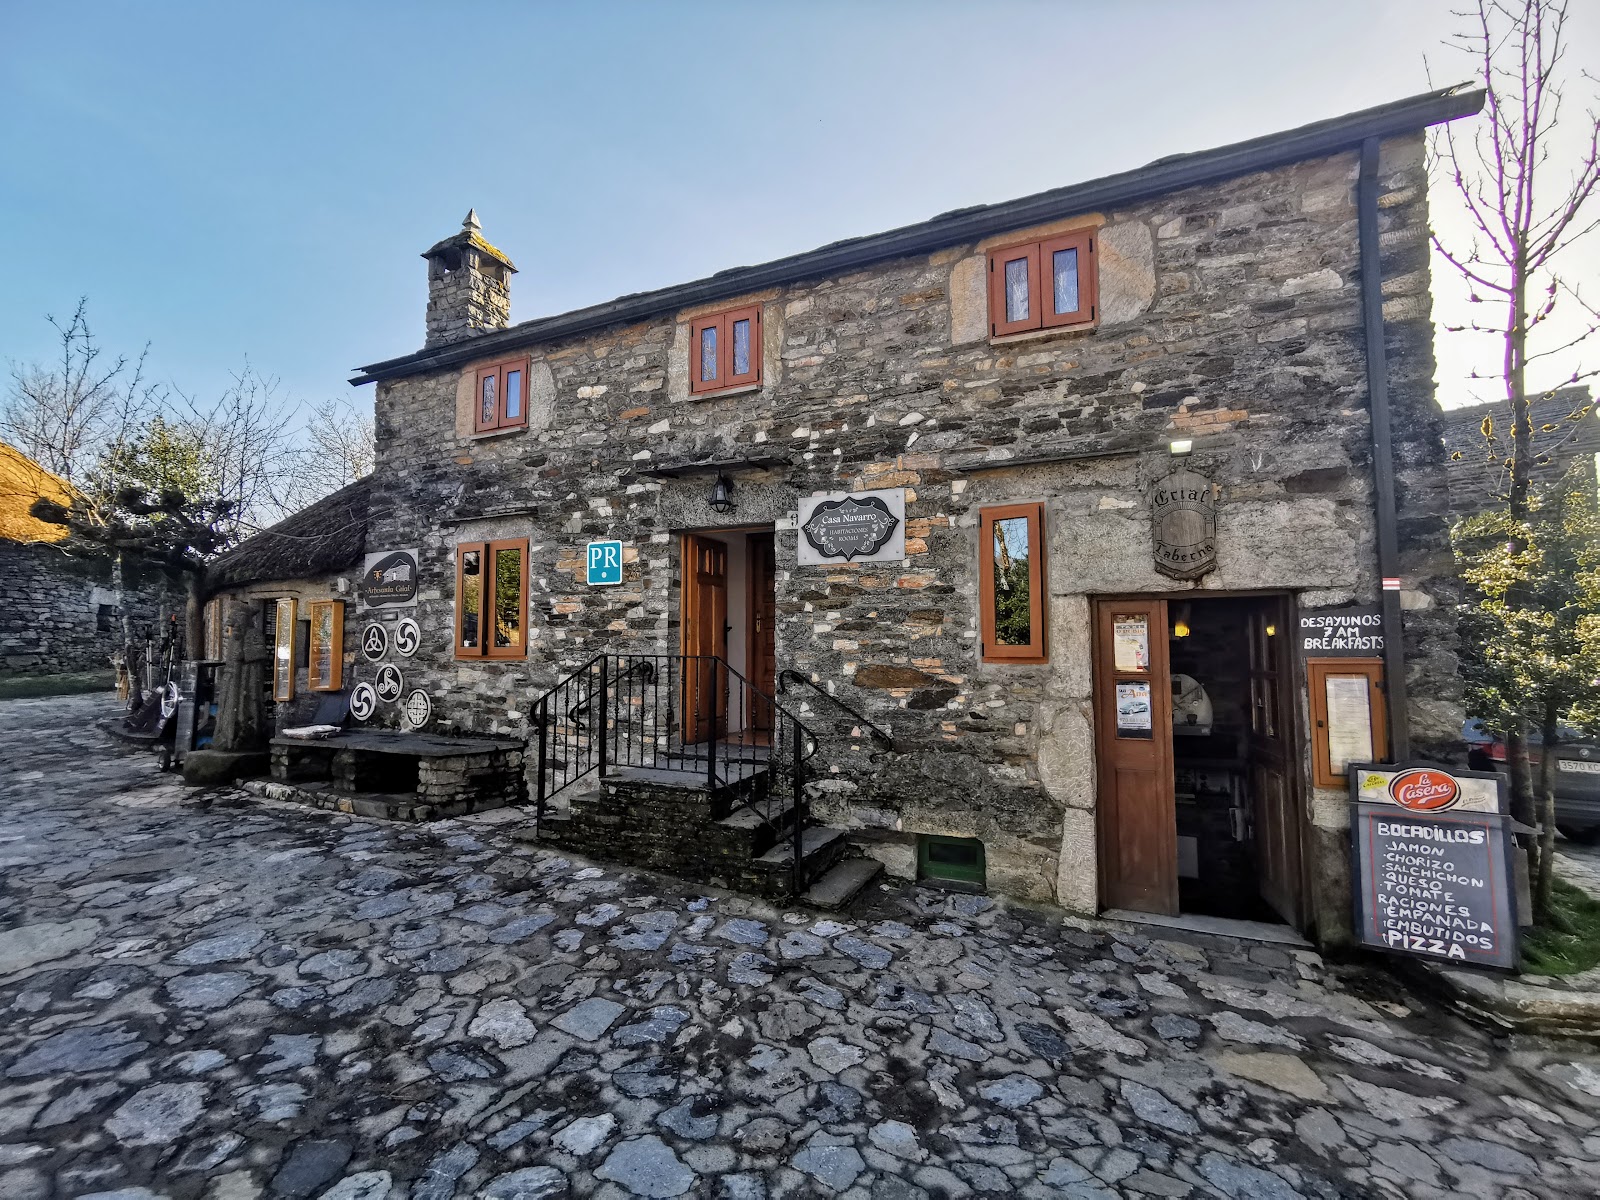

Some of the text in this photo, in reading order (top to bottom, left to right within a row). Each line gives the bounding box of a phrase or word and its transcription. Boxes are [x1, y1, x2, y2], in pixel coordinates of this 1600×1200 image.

[822, 513, 877, 524] Casa Navarro
[829, 527, 869, 536] HABITACIONES
[590, 546, 619, 569] PR
[1155, 542, 1214, 561] Taberna
[1300, 614, 1381, 628] DESAYUNOS
[1323, 627, 1360, 638] 7 AM
[1303, 635, 1384, 650] BREAKFASTS
[1561, 761, 1585, 771] 3570
[1415, 774, 1432, 788] La
[1399, 782, 1452, 804] Casera
[1378, 822, 1485, 845] BOCADILLOS
[1387, 841, 1444, 856] JAMON
[1386, 853, 1455, 872] CHORIZO
[1385, 862, 1484, 888] SALCHICHON
[1386, 872, 1443, 891] QUESO
[1383, 881, 1455, 902] TOMATE
[1378, 893, 1471, 917] RACIONES
[1387, 905, 1494, 934] EMPANADA
[1387, 920, 1493, 949] EMBUTIDOS
[1388, 929, 1466, 960] PIZZA
